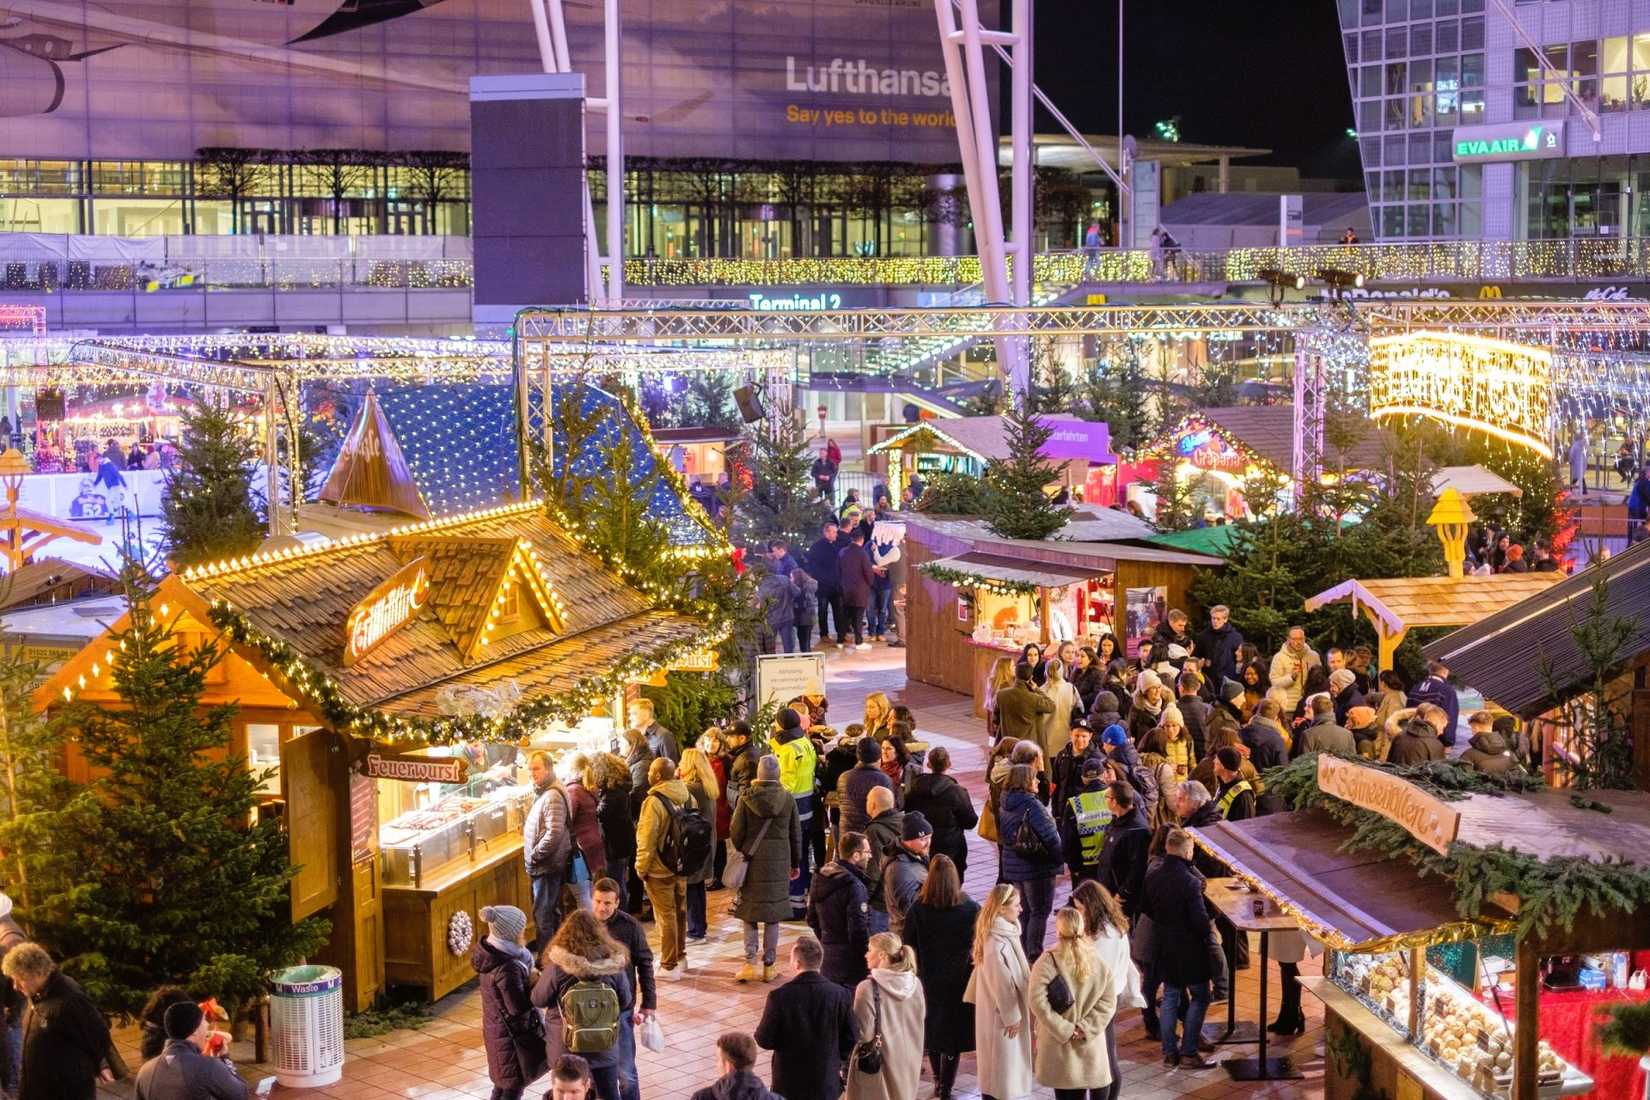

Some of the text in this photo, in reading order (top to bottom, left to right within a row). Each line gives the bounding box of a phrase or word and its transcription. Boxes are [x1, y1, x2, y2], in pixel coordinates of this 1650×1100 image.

[786, 104, 820, 126] Say
[824, 109, 853, 127] yes
[860, 108, 877, 124] to
[881, 107, 908, 125] the
[749, 293, 826, 310] Terminal
[368, 754, 460, 781] Feuerwurst
[292, 984, 319, 993] Waste
